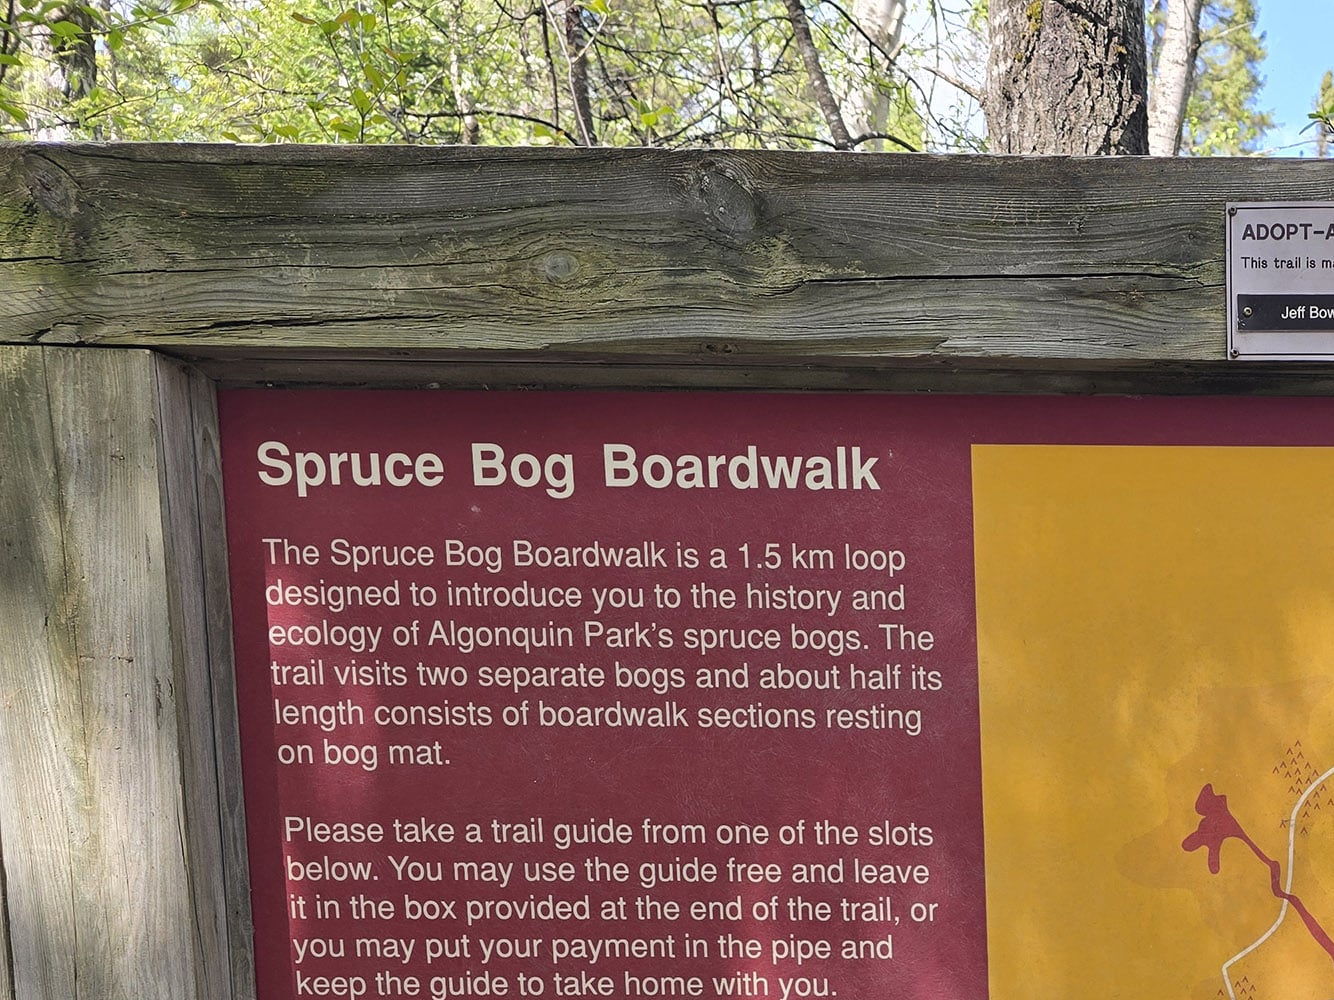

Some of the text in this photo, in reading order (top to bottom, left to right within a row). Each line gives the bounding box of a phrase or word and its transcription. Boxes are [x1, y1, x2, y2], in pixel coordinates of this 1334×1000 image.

[1241, 257, 1268, 269] This
[1274, 257, 1301, 269] trail
[1306, 256, 1316, 268] is
[1281, 306, 1306, 319] Jeff
[257, 441, 881, 499] Spruce Bog Boardwalk
[275, 699, 921, 736] length consists of boardwalk sections resting
[287, 855, 929, 888] below. You may use the guide free and leave
